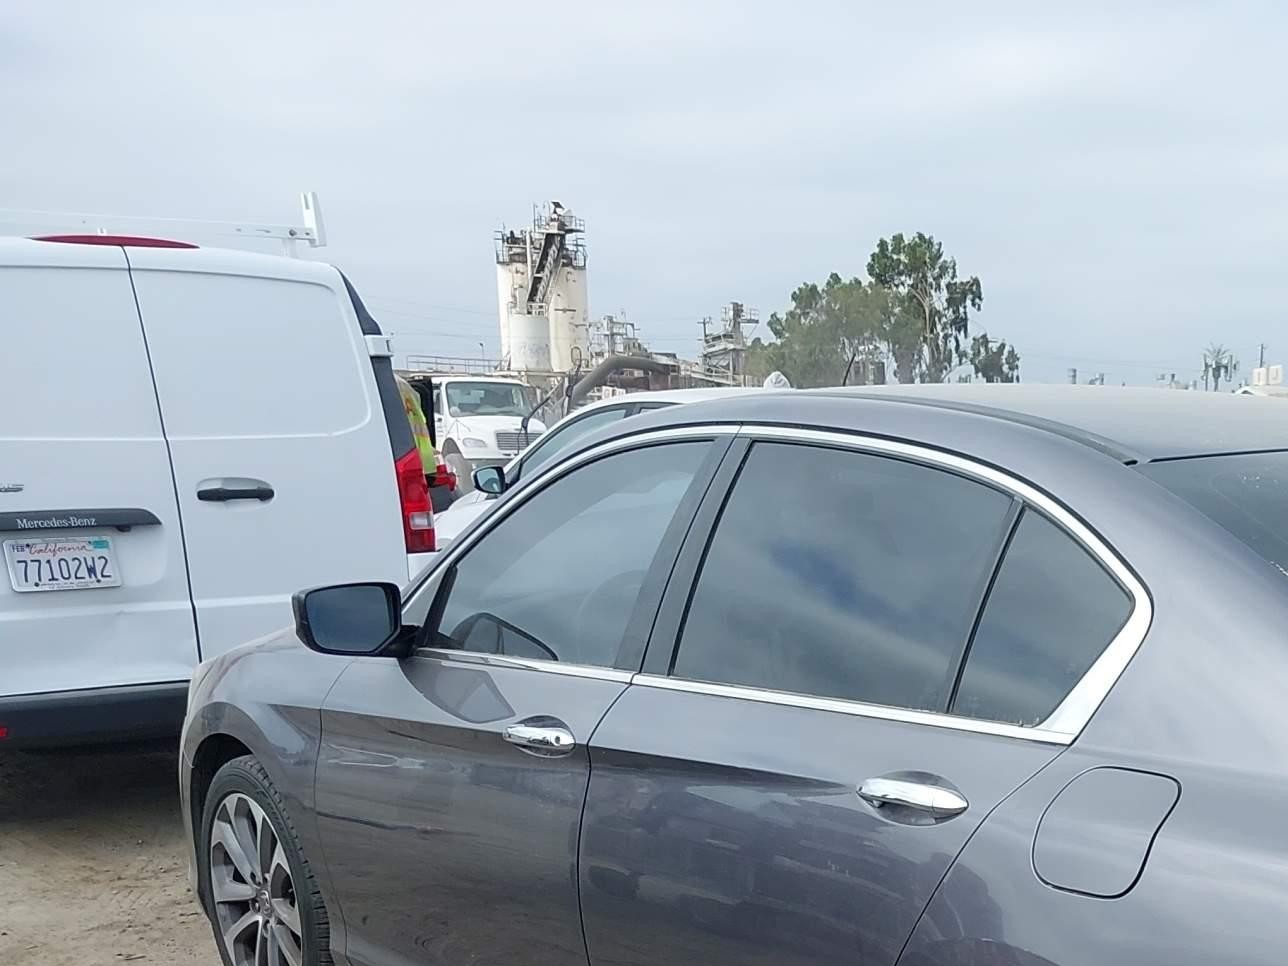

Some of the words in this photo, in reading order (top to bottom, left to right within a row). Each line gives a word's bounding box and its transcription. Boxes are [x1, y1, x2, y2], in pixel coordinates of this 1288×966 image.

[16, 517, 97, 529] Mercedes-Benz
[29, 543, 92, 556] California
[16, 555, 112, 583] 77102W2
